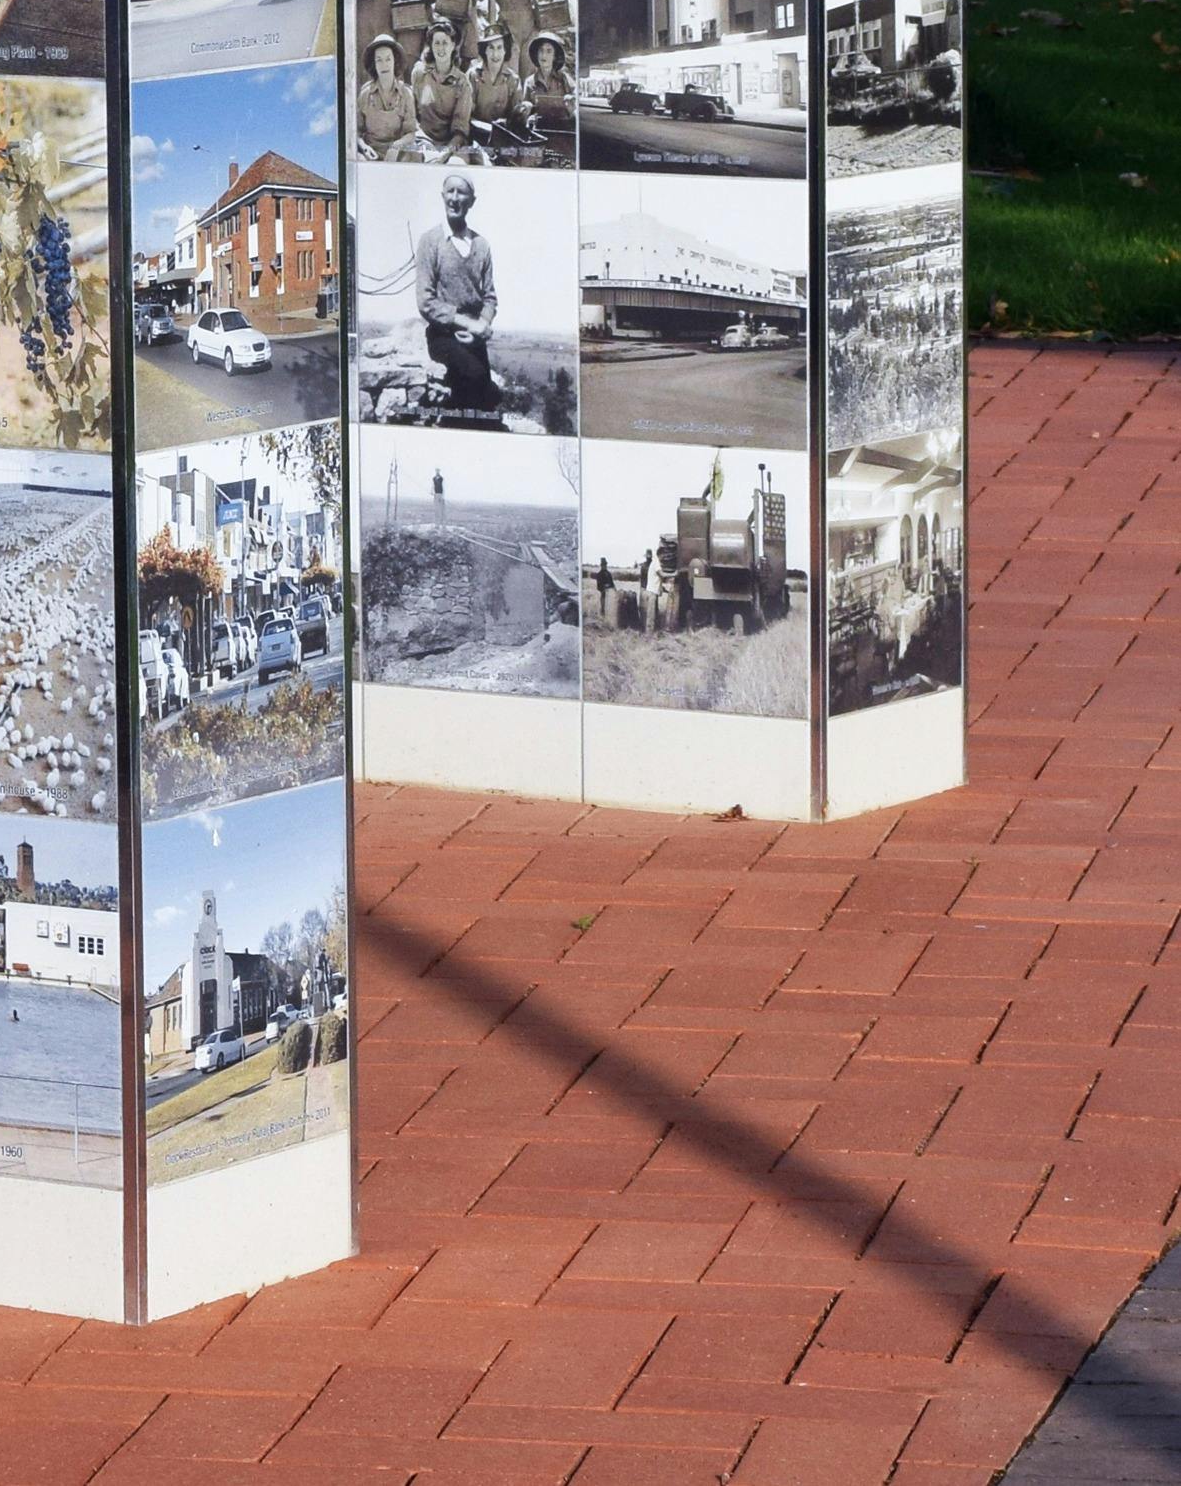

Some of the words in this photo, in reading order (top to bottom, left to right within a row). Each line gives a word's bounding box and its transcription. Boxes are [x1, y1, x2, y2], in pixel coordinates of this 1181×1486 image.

[191, 39, 240, 54] Commonwealth
[242, 36, 257, 48] Bank
[264, 33, 280, 45] 2012
[11, 46, 36, 59] Plant
[46, 787, 68, 800] 1988
[0, 1145, 23, 1158] 1960
